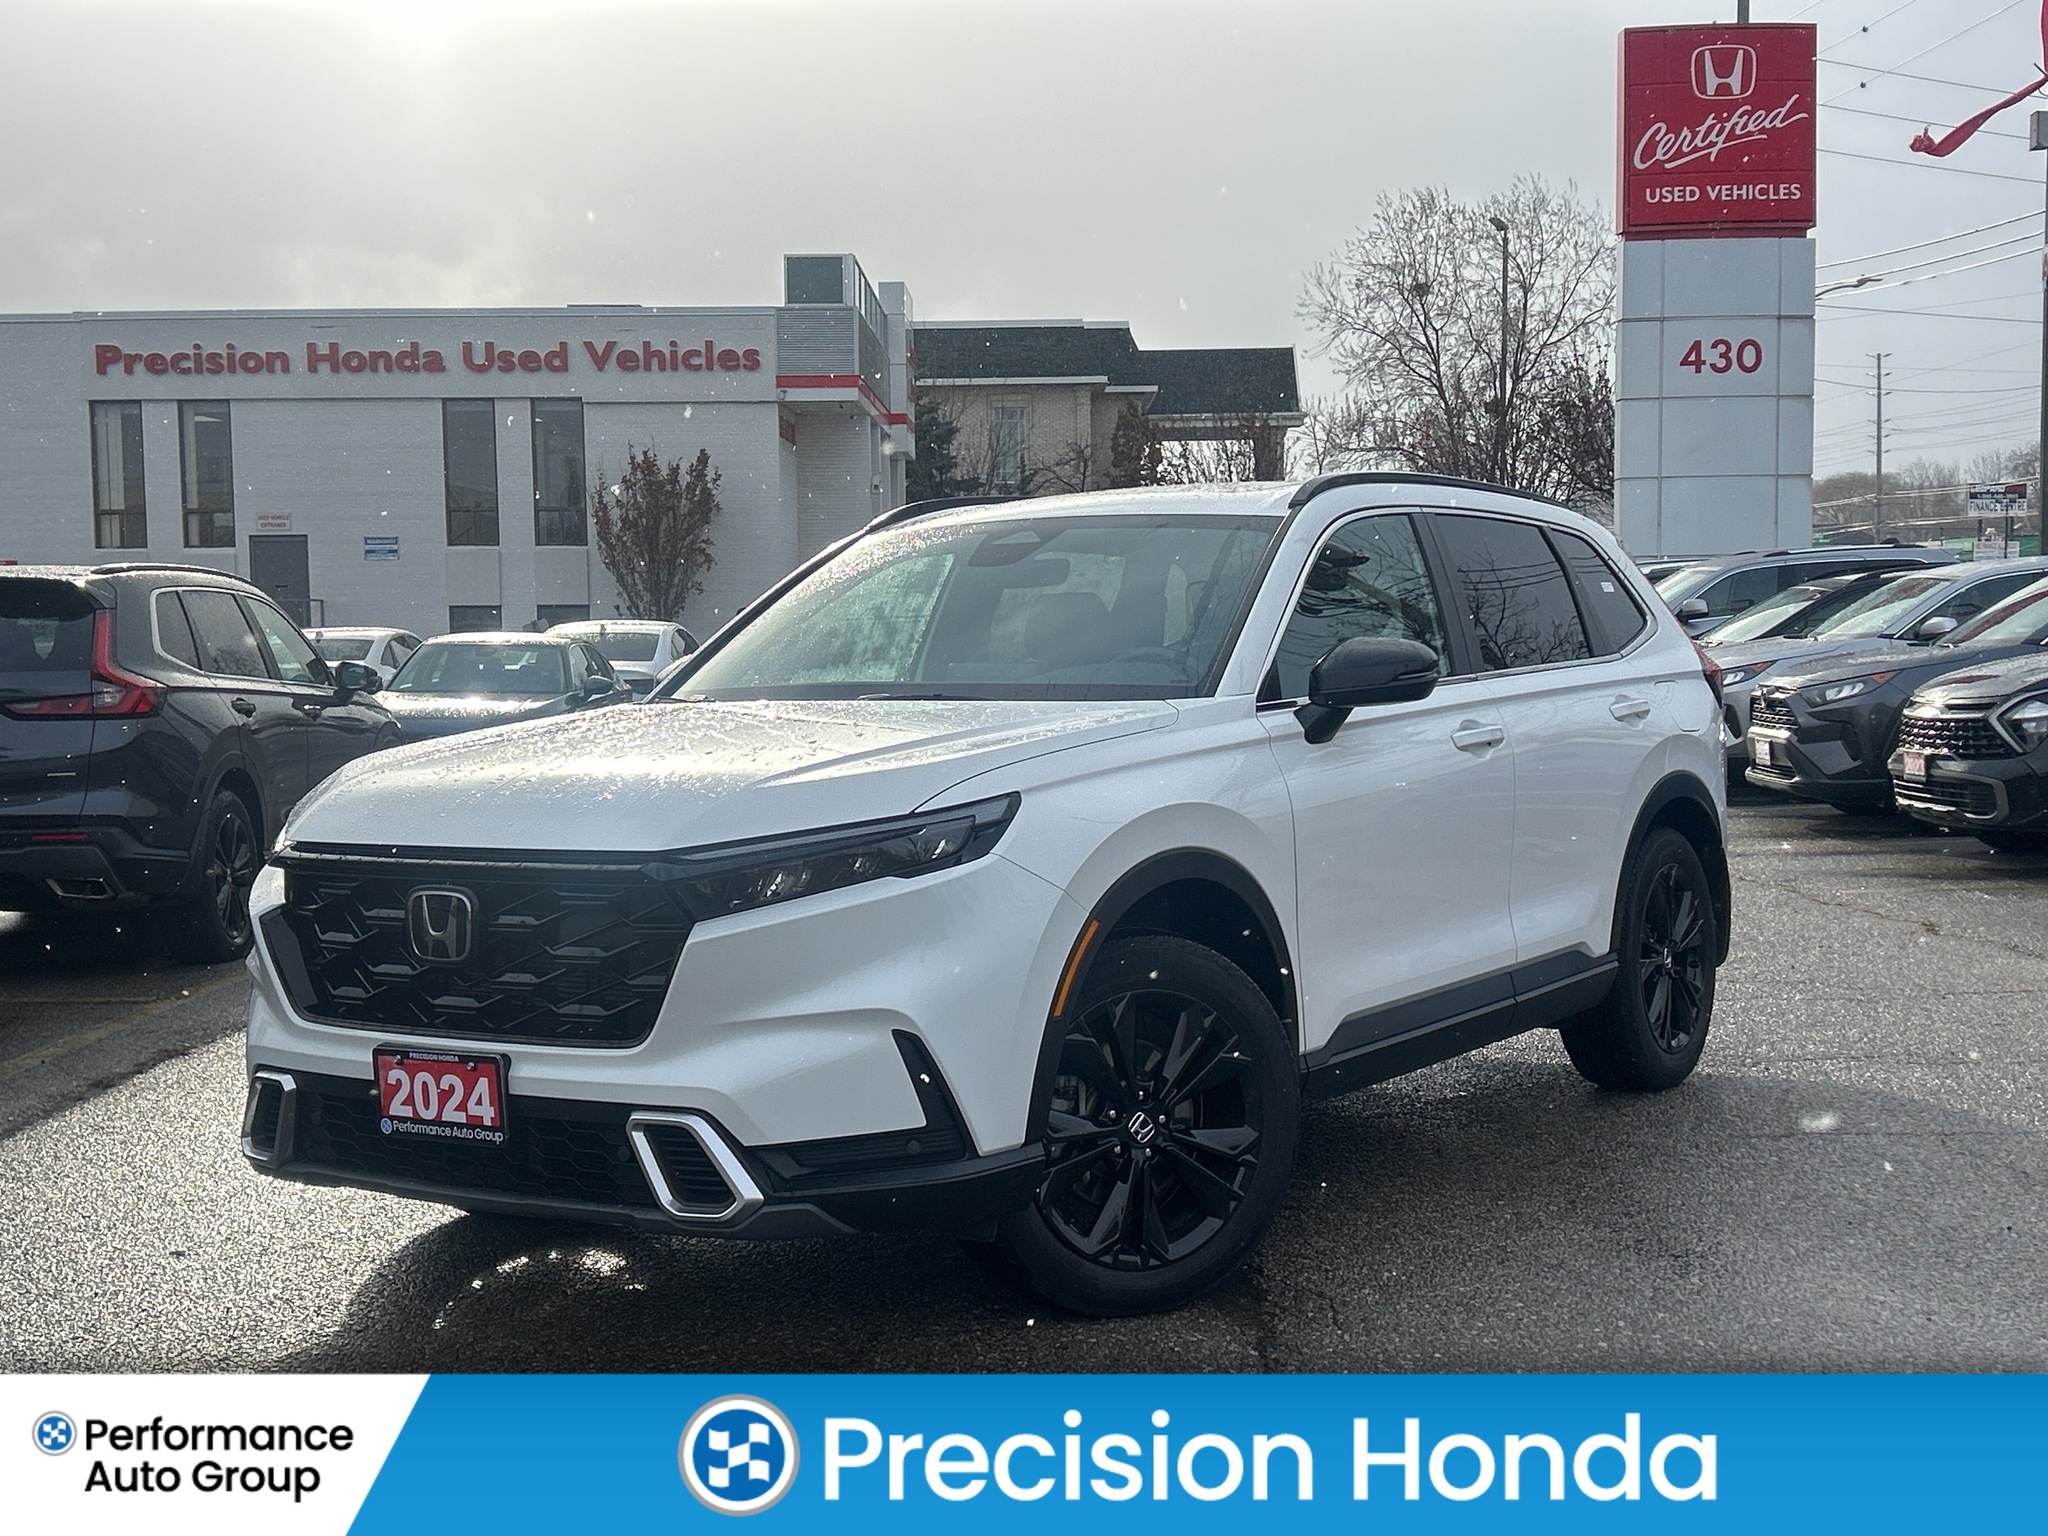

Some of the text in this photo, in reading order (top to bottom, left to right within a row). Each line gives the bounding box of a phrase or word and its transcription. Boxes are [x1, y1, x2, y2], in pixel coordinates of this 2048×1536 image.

[1633, 94, 1809, 170] Certified
[1645, 183, 1801, 203] USED VEHICLES
[95, 339, 761, 375] Precision Honda Used Vehicles
[1679, 339, 1763, 374] 430
[1970, 501, 1999, 512] FINANCE
[409, 1052, 459, 1062] PRECISION HONDA
[387, 1068, 495, 1126] 2024
[393, 1120, 503, 1145] Performance Auto Group
